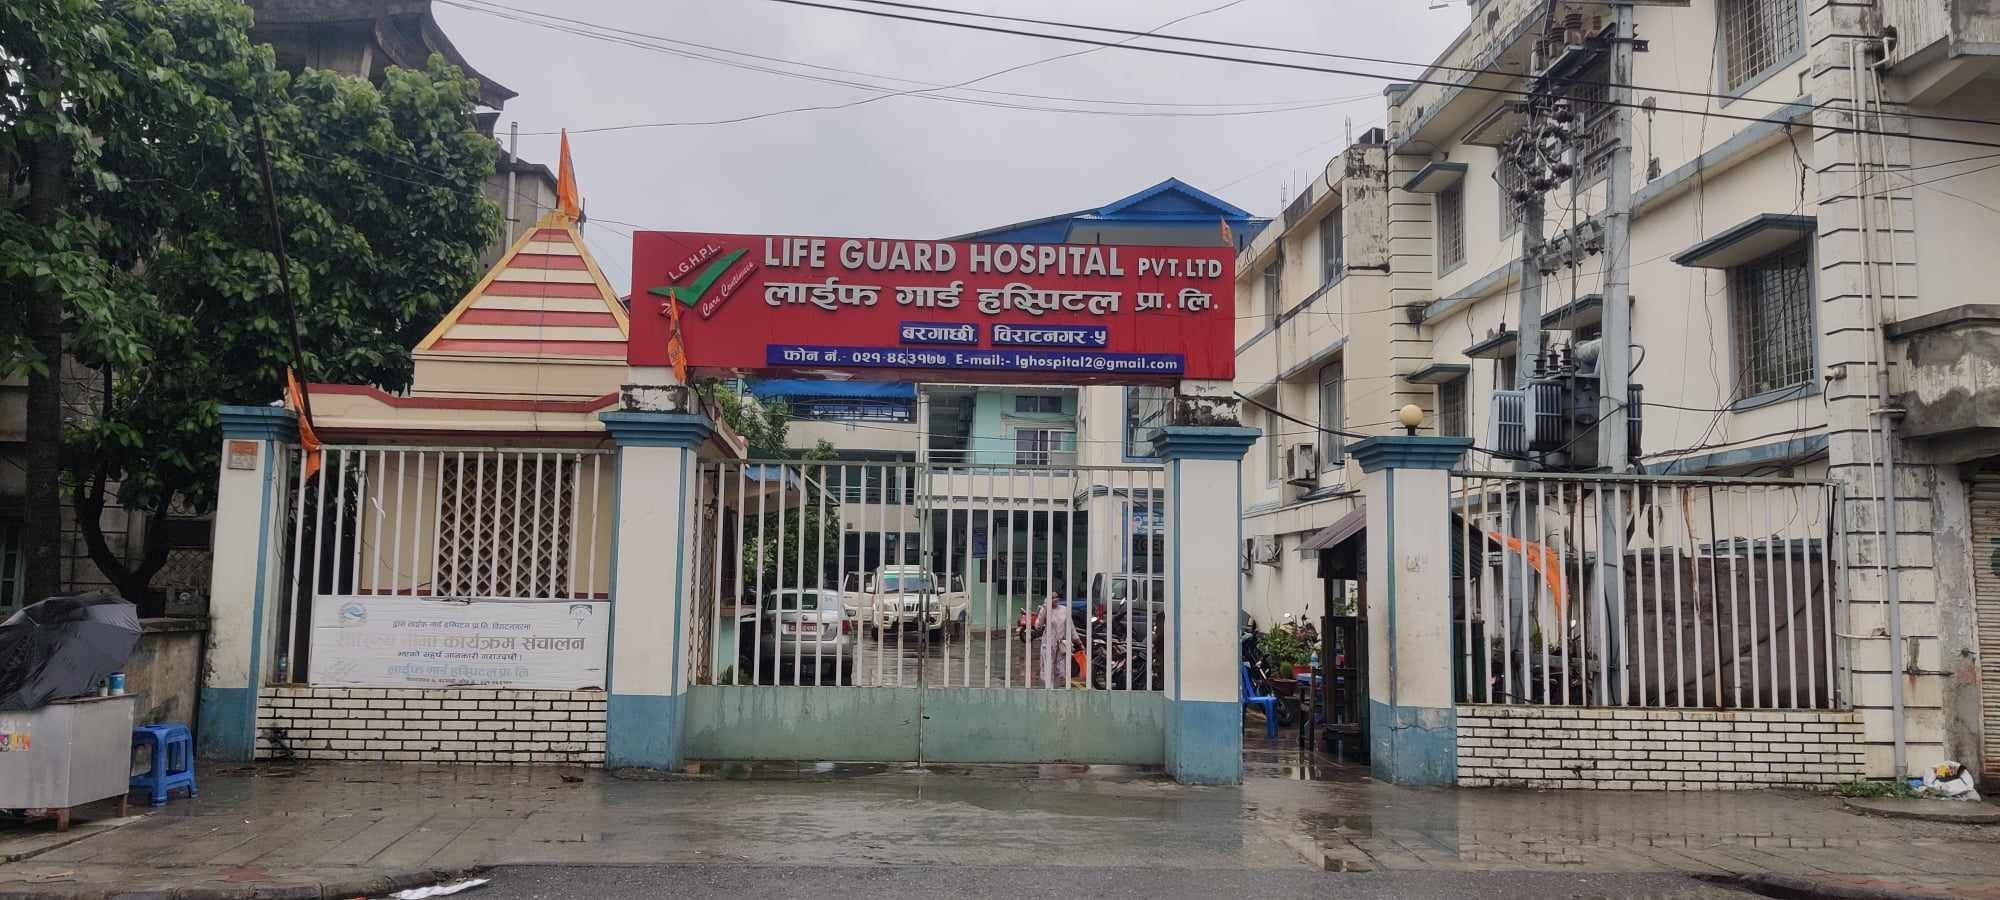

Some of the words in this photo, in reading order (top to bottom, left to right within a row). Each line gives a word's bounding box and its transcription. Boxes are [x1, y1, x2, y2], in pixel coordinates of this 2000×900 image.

[764, 237, 826, 268] LIFE
[839, 239, 957, 272] GUARD
[969, 243, 1124, 277] HOSPITAL
[1137, 257, 1223, 278] PVT.LTD
[764, 276, 881, 311] लाईफ
[896, 280, 964, 308] गार्ड
[977, 282, 1122, 315] हस्पिटल
[784, 347, 818, 362] फोन
[1015, 354, 1178, 370] lghospital2@gmail.com
[443, 632, 515, 651] कार्यक्रम
[521, 634, 585, 651] संचालन
